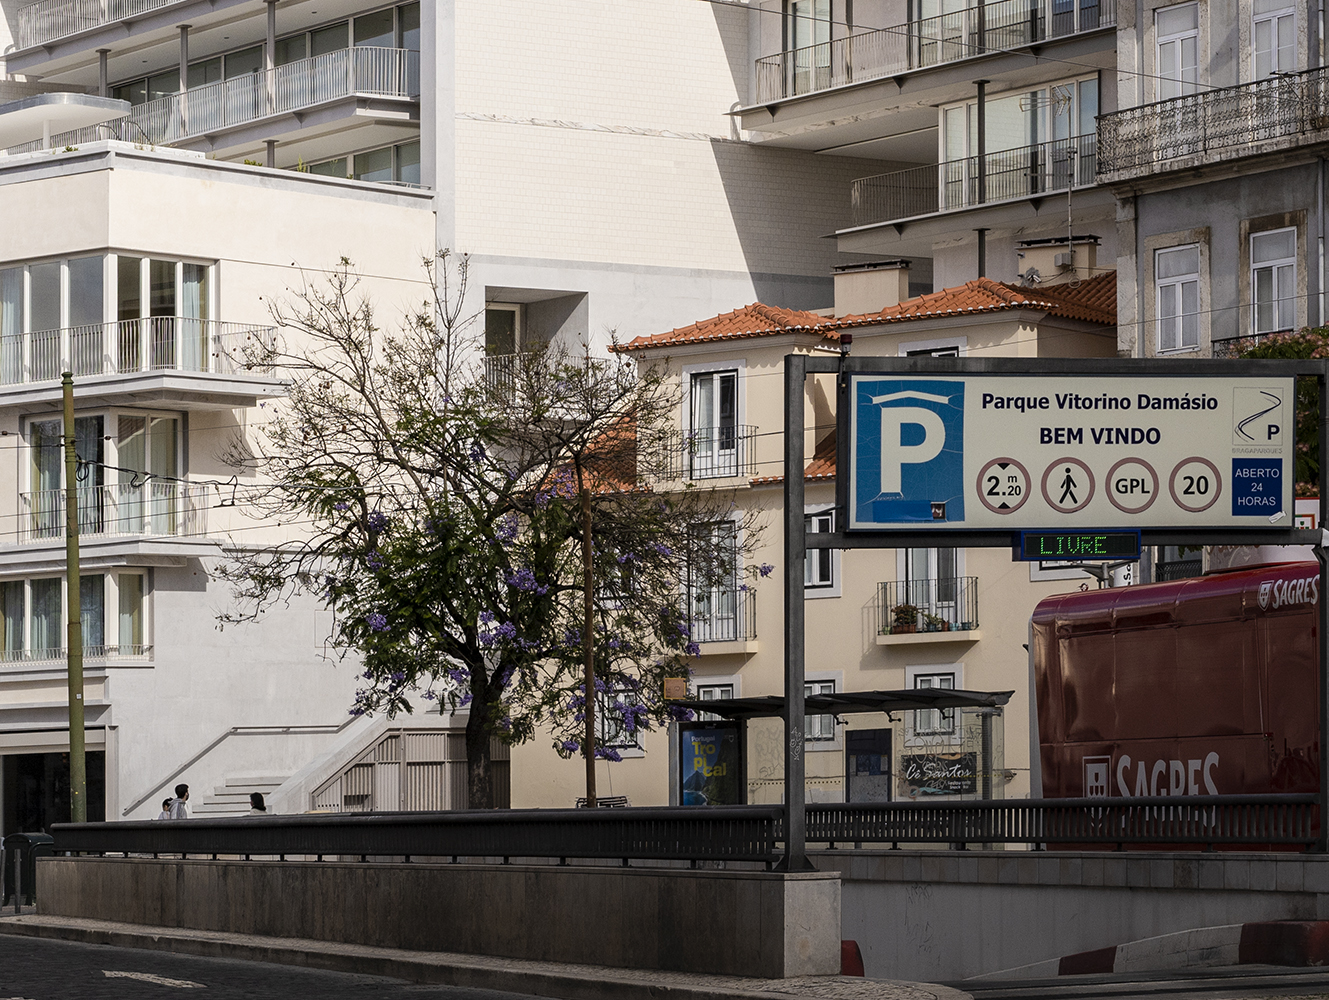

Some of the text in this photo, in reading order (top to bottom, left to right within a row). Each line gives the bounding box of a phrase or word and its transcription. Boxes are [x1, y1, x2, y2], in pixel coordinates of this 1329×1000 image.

[981, 392, 1218, 413] Parque Vitorino Damásio
[1040, 427, 1161, 445] BEM VINDO
[1267, 424, 1280, 440] P
[881, 407, 946, 493] P
[1235, 468, 1280, 478] ABERTO
[1115, 478, 1150, 494] GPL
[1182, 475, 1209, 495] 20
[1251, 483, 1263, 491] 24
[1237, 496, 1276, 506] HORAS
[1040, 536, 1107, 554] LIVRE
[1272, 574, 1320, 609] SAGRES
[692, 742, 716, 755] Tro
[703, 763, 727, 777] cal
